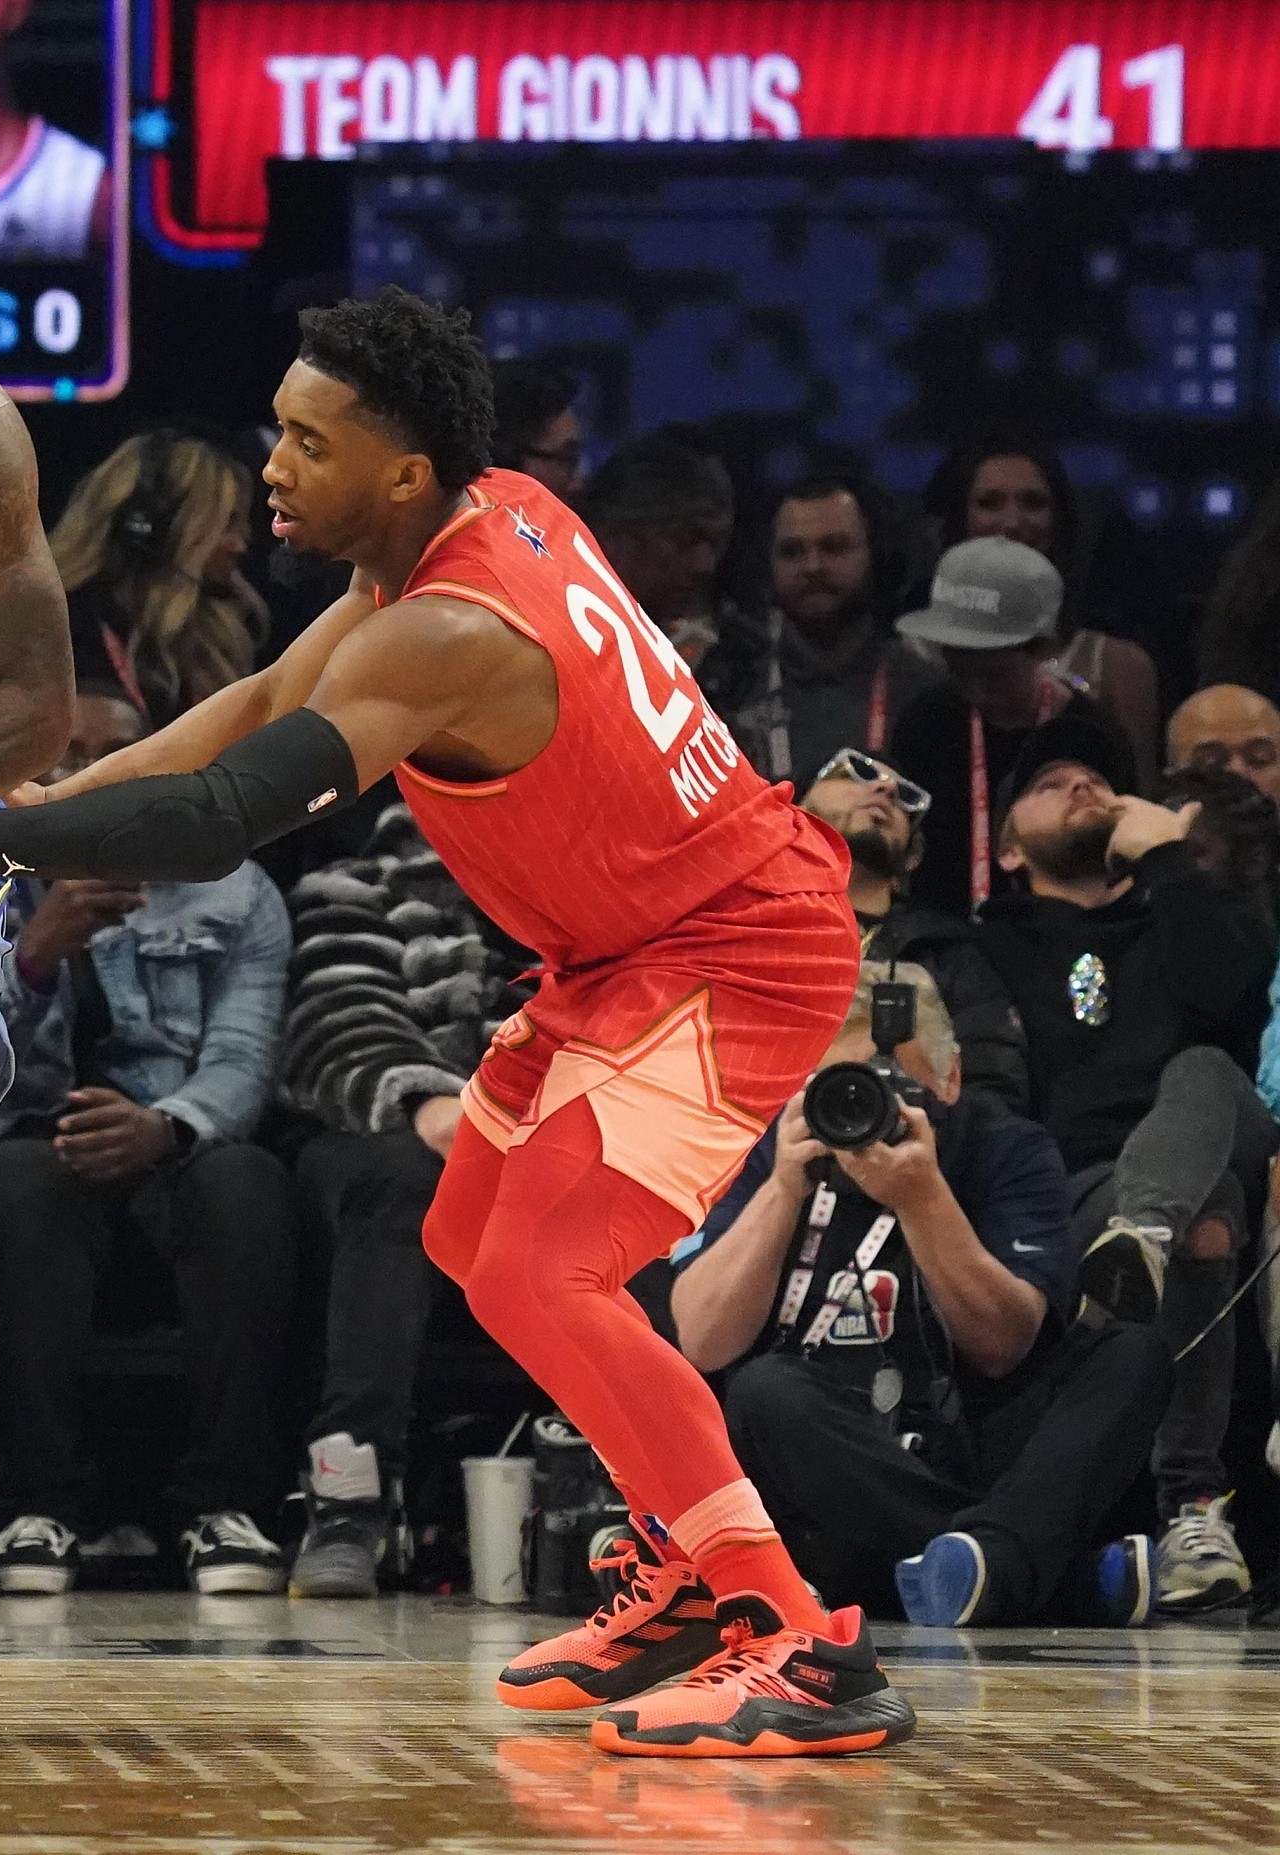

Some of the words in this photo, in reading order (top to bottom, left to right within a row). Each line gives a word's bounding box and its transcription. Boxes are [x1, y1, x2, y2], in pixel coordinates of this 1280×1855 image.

[1016, 43, 1185, 151] 41
[33, 288, 82, 354] 0
[565, 531, 694, 754] 24
